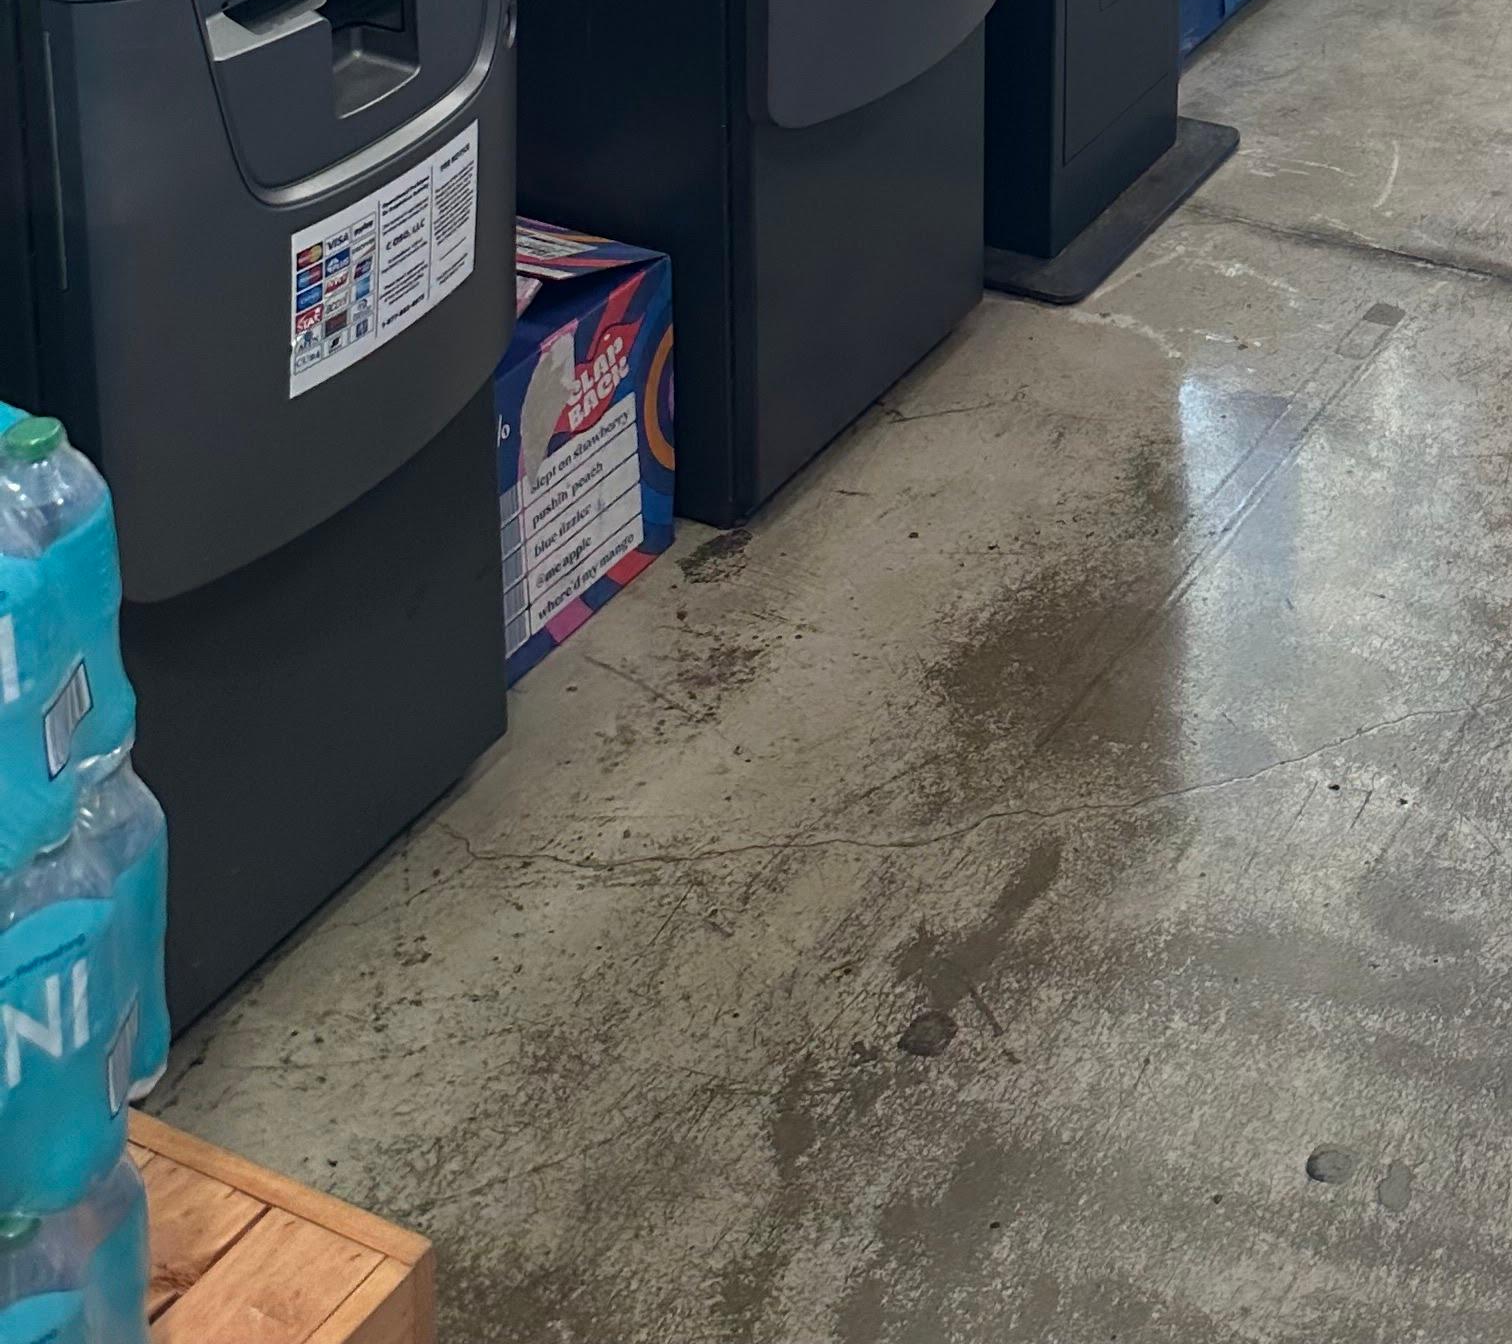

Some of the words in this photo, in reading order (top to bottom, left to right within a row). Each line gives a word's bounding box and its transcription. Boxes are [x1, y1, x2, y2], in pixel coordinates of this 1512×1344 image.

[327, 232, 349, 251] VISA
[296, 310, 321, 331] STAR
[567, 355, 630, 432] BACK
[557, 454, 573, 472] on
[572, 409, 631, 462] strawberry
[571, 461, 605, 500] peach
[533, 529, 559, 559] blue
[561, 535, 593, 575] apple
[581, 561, 600, 589] my
[599, 532, 636, 569] mango
